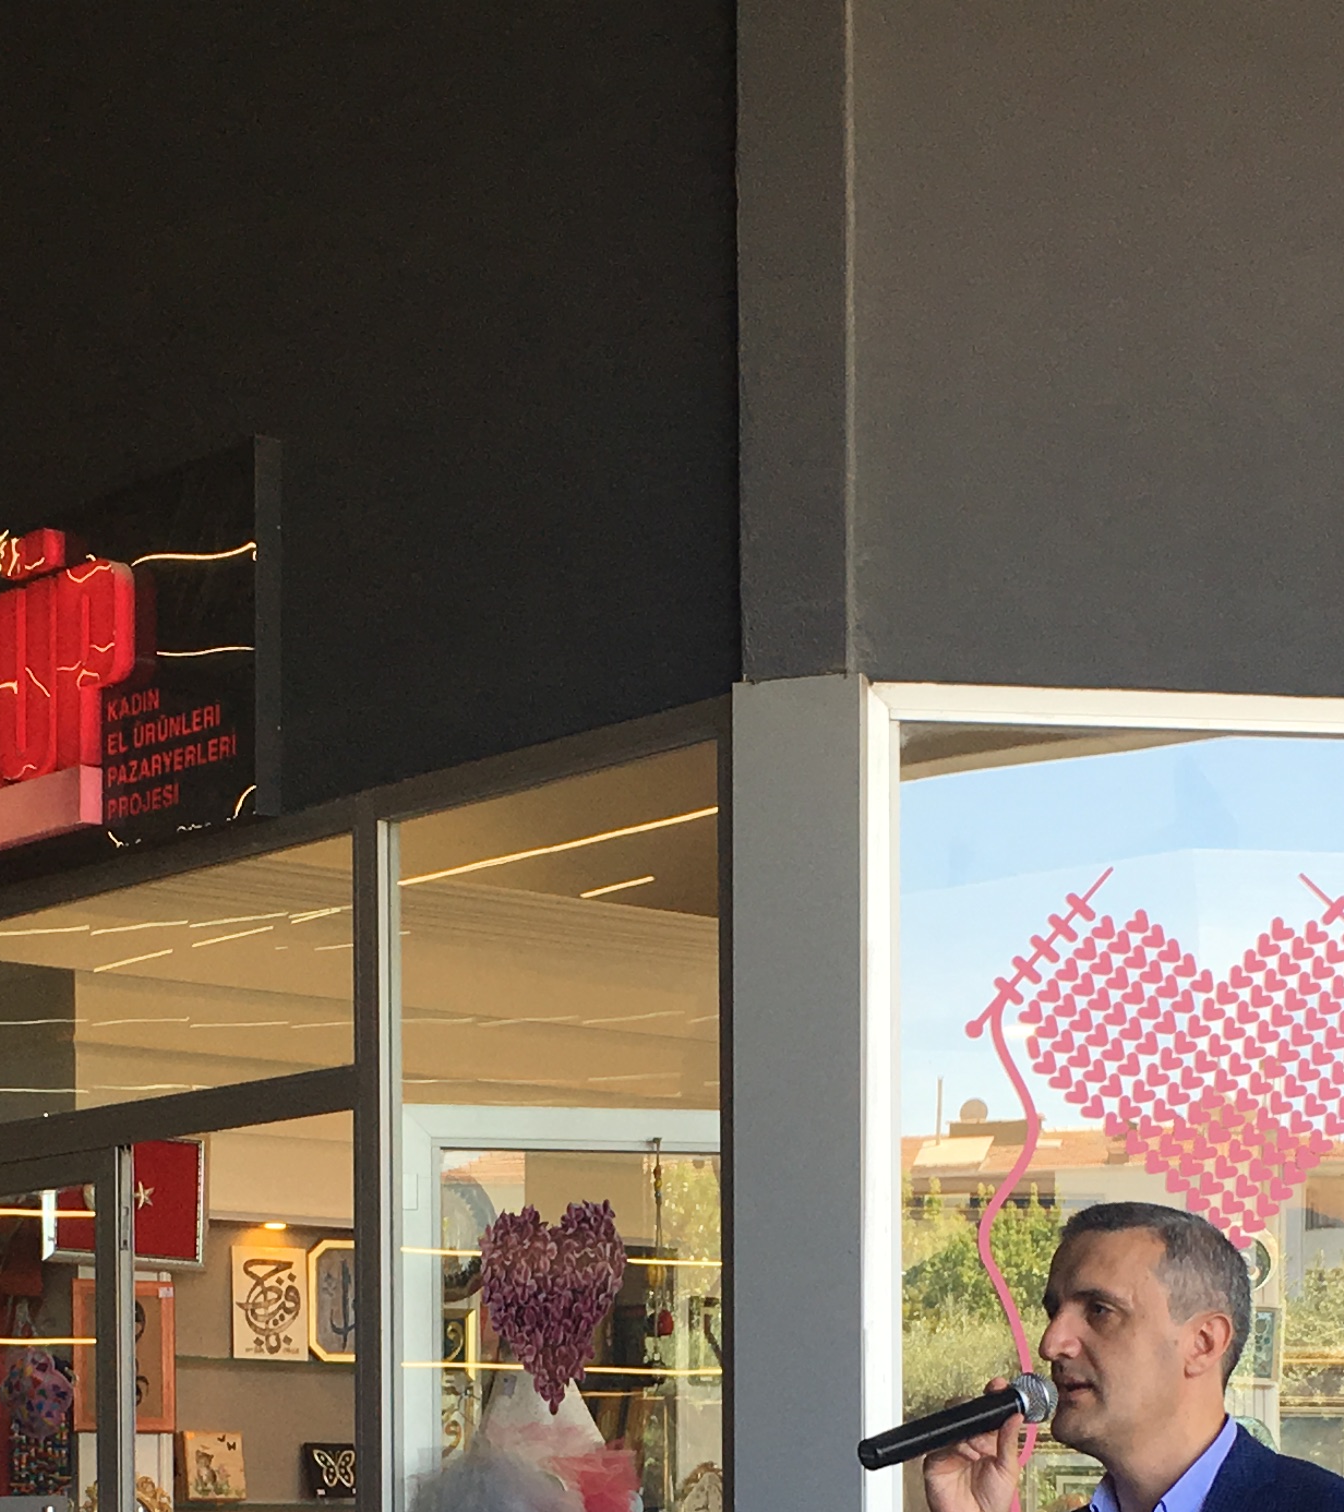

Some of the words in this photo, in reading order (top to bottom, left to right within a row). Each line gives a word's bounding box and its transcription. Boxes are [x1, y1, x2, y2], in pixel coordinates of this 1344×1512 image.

[107, 688, 159, 722] KADIN
[107, 731, 128, 755] EL
[133, 702, 221, 749] ÜRÜNLERİ
[107, 730, 236, 788] PAZARYERLERİ
